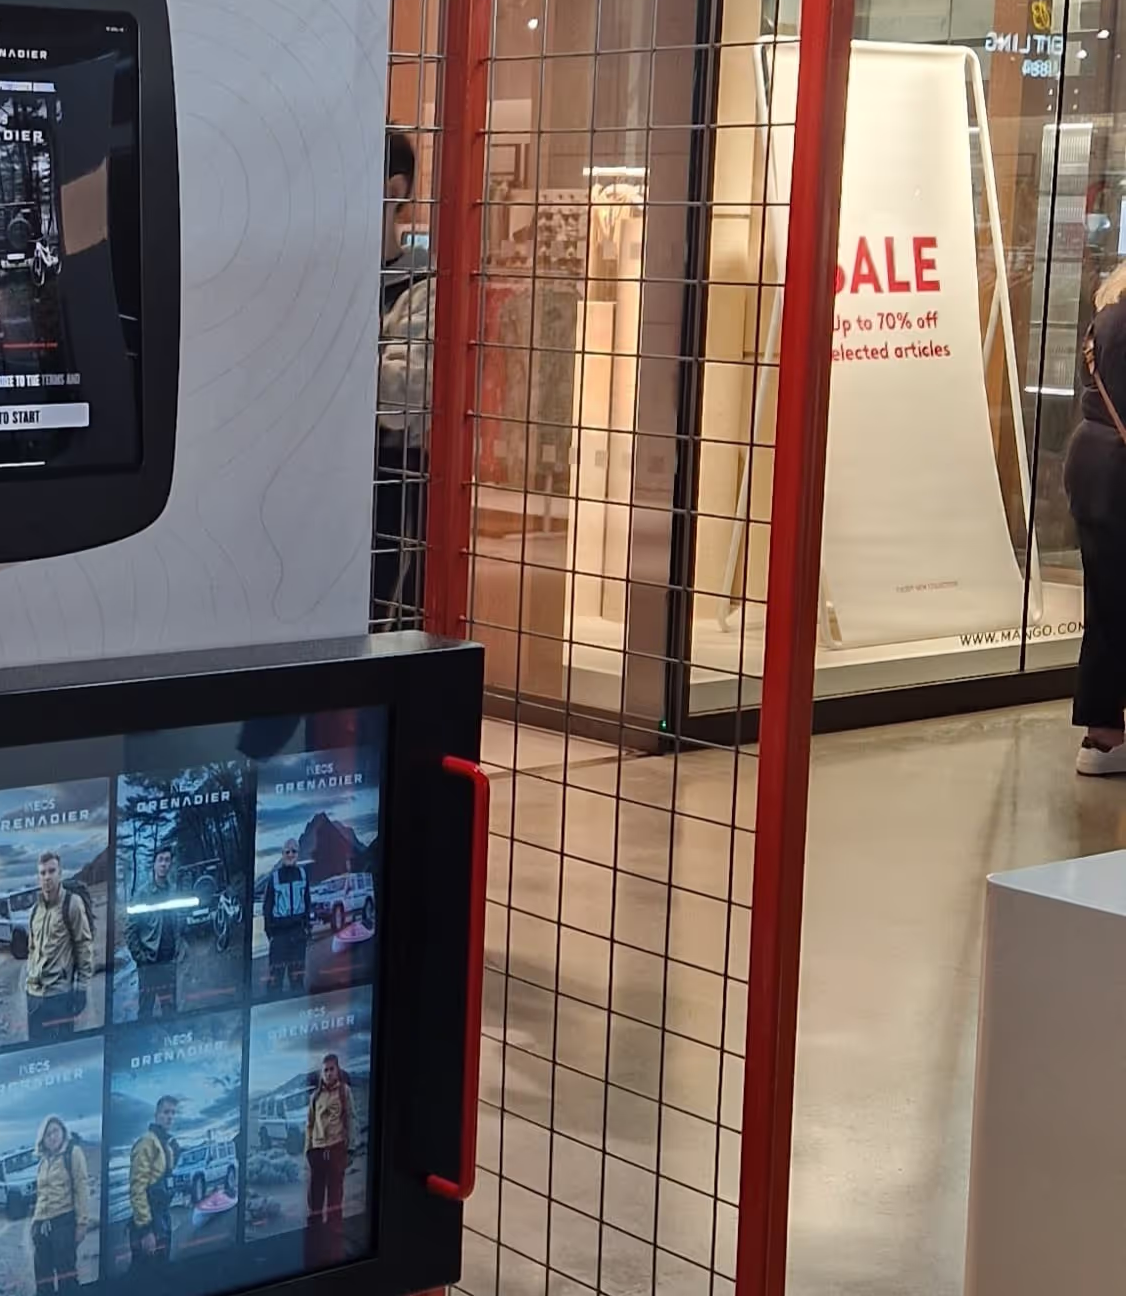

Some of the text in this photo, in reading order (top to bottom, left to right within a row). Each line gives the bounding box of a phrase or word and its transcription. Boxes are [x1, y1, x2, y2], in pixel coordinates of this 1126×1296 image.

[856, 315, 872, 331] to
[877, 312, 912, 330] 70%
[917, 311, 938, 329] off
[832, 340, 951, 361] elected articles
[16, 375, 25, 387] TO
[26, 374, 40, 387] THE
[13, 410, 40, 424] START
[275, 773, 362, 794] GRENADIER
[137, 790, 230, 813] GRENADIER
